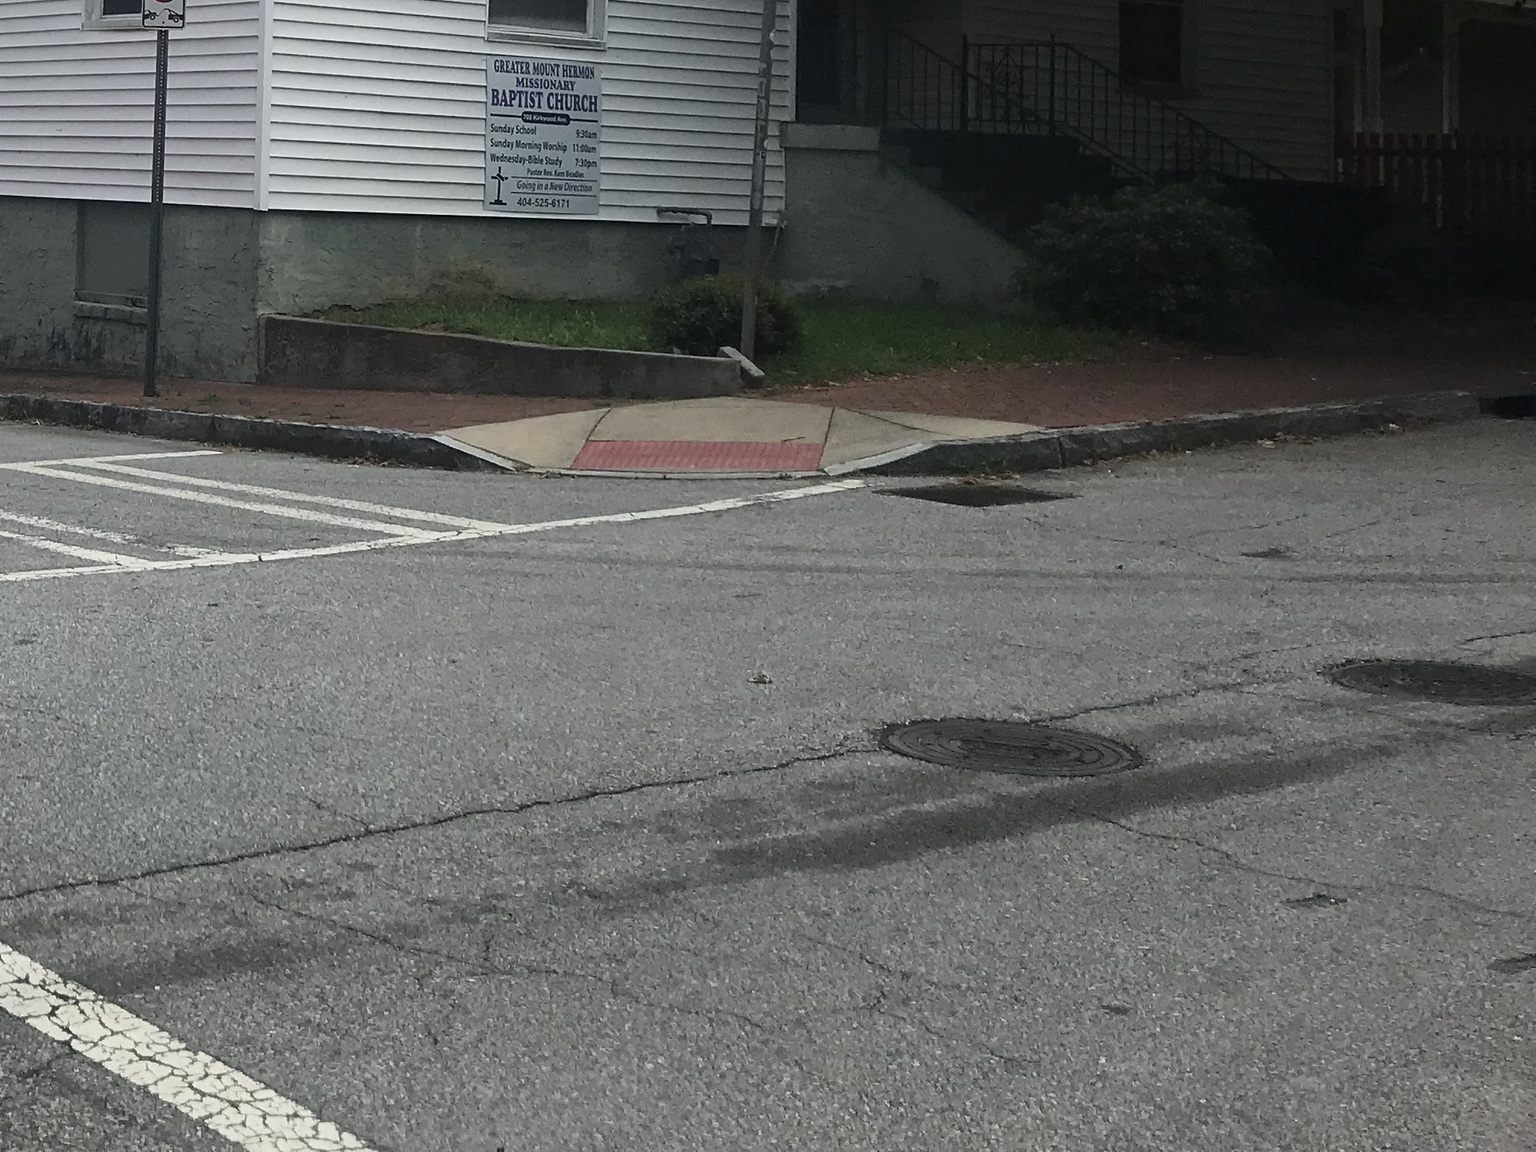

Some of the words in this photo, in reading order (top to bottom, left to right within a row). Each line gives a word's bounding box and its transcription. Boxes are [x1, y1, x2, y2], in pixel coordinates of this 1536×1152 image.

[494, 59, 530, 76] GREATER
[532, 62, 560, 77] MOUNT
[562, 64, 595, 80] HERMON
[516, 77, 576, 91] MISSIONARY
[491, 88, 544, 110] BAPTIST
[546, 92, 598, 112] CHURCH
[533, 114, 556, 122] Kirkwood
[490, 124, 514, 136] Sunday
[516, 125, 536, 135] School
[576, 129, 597, 138] 9:30am
[490, 138, 514, 150] Sunday
[516, 140, 542, 152] Morning
[542, 142, 568, 154] Worship
[572, 144, 596, 153] 11:00am
[490, 152, 544, 165] Wednesday-Bible
[545, 156, 562, 167] Study
[575, 158, 597, 168] 7:30pm
[516, 180, 536, 192] Going
[564, 183, 592, 192] Direction
[516, 198, 570, 208] 404-525-6171
